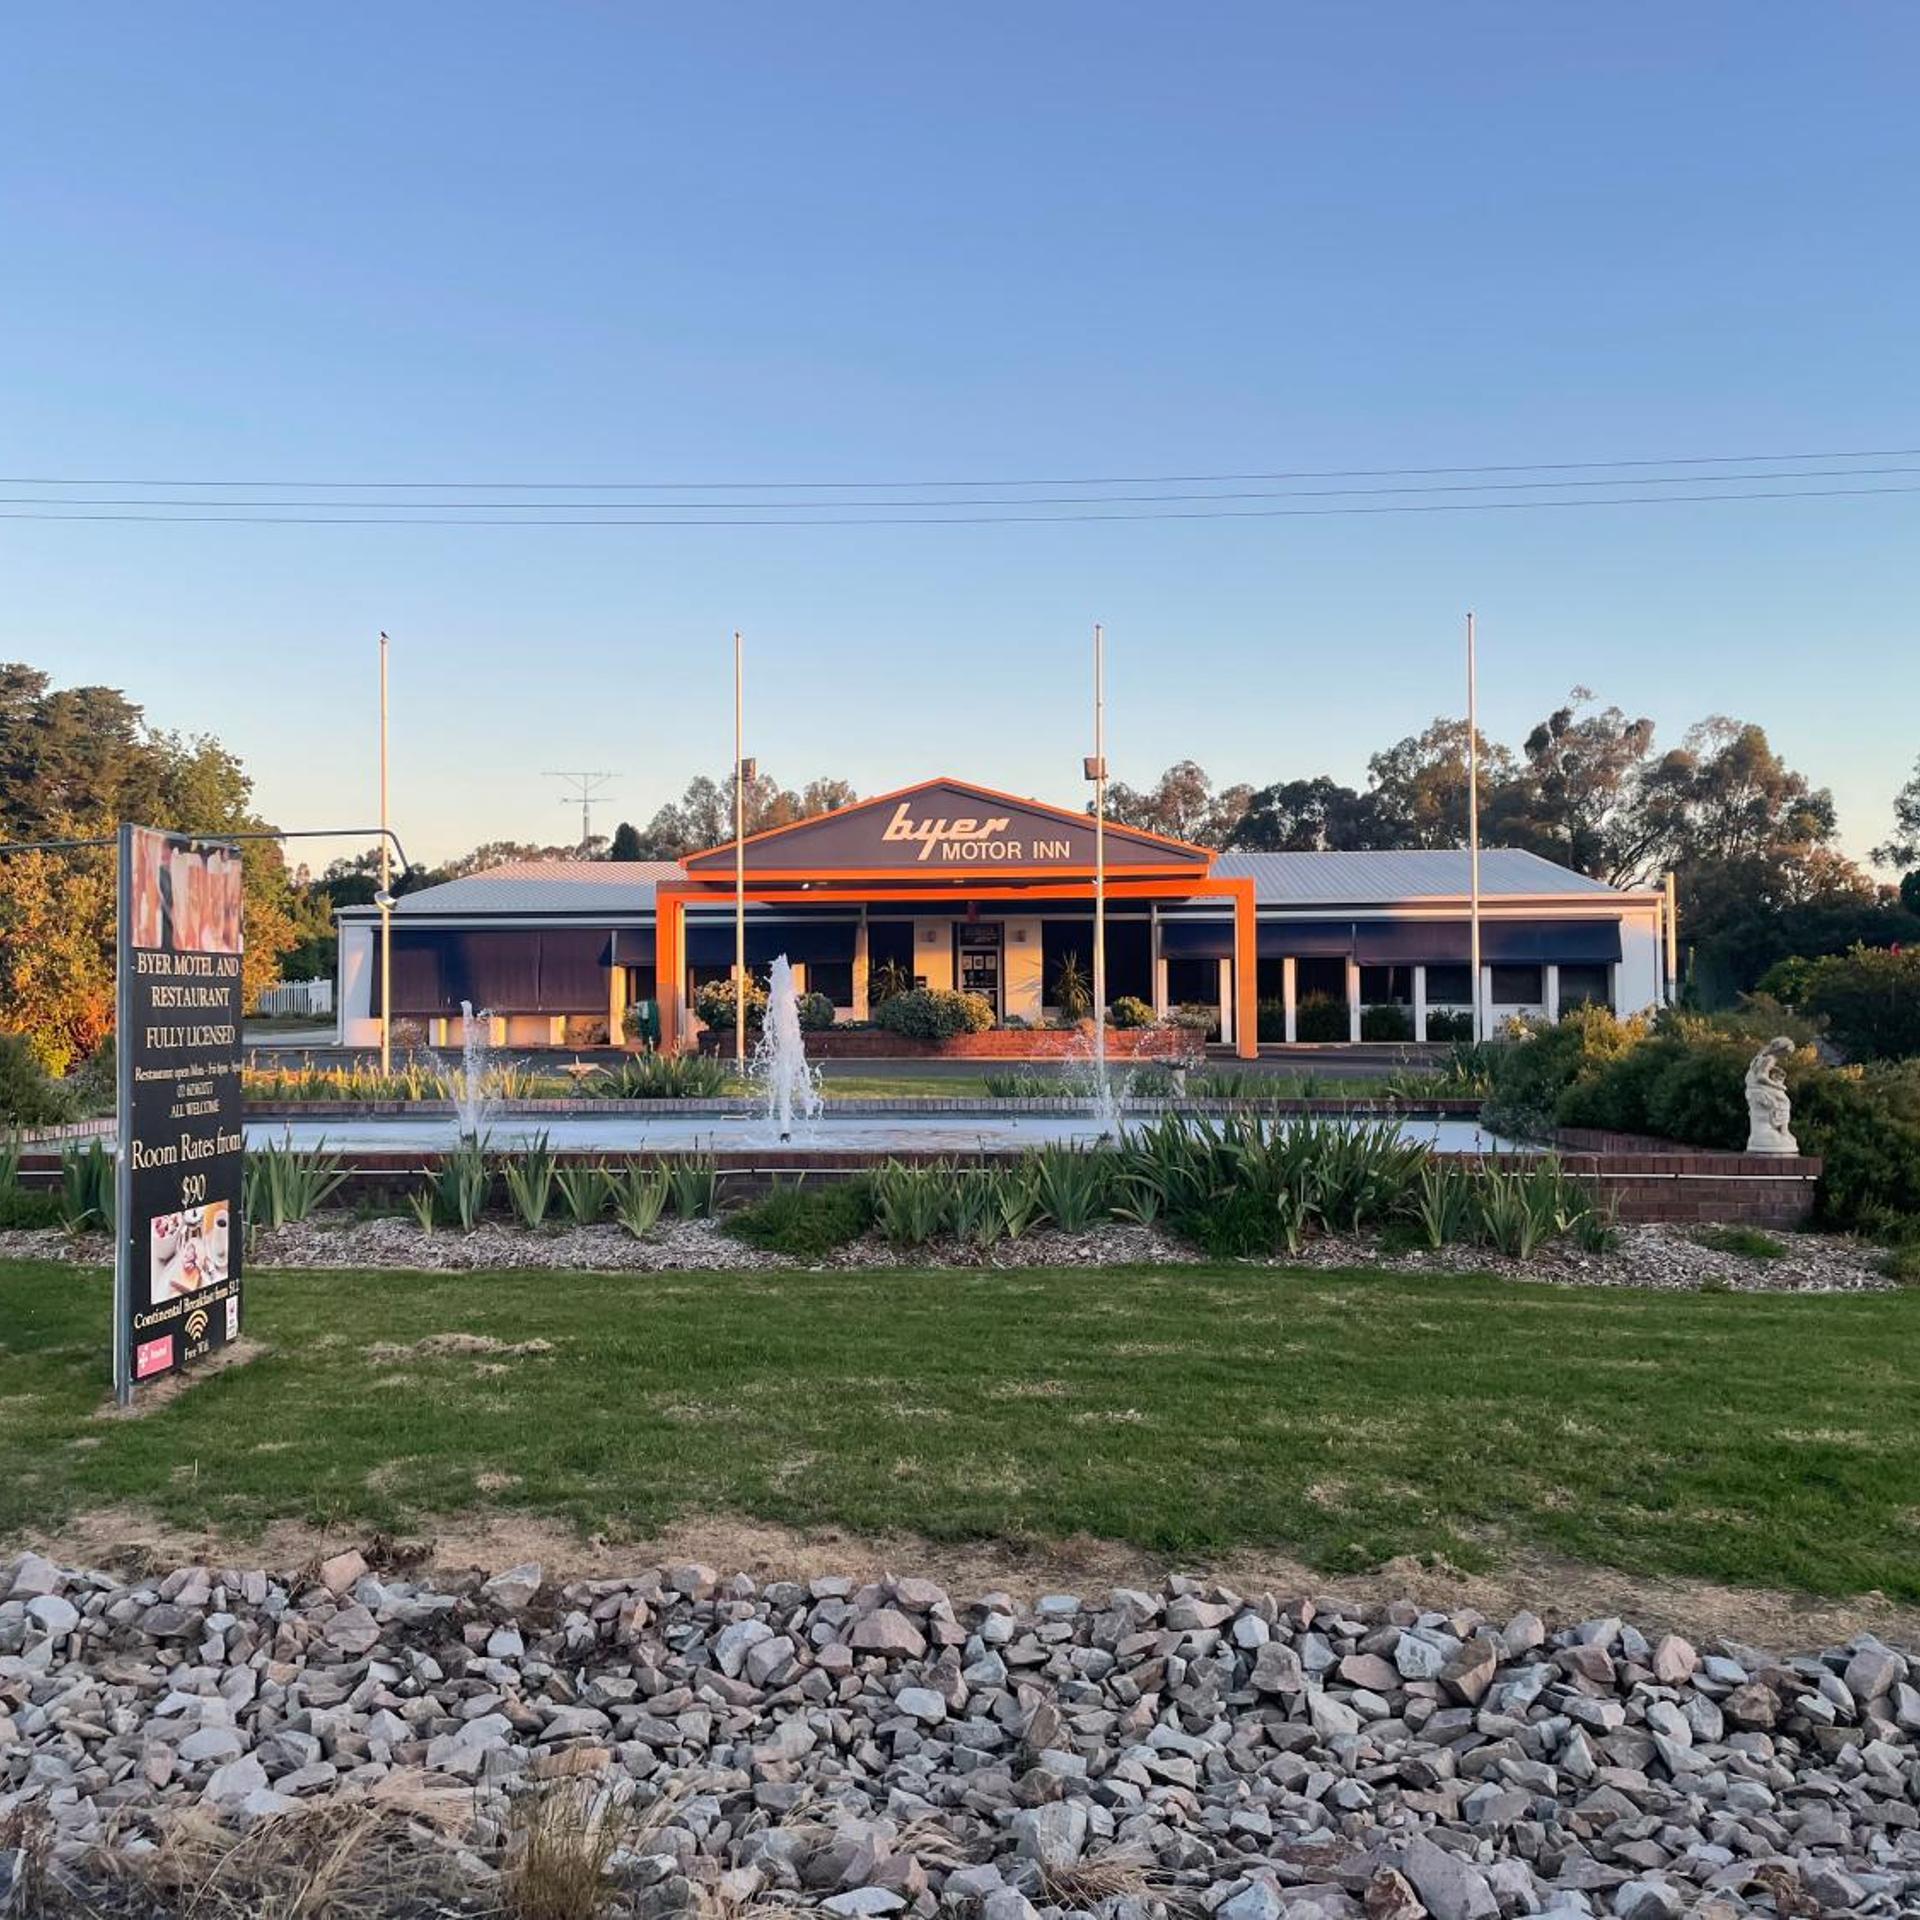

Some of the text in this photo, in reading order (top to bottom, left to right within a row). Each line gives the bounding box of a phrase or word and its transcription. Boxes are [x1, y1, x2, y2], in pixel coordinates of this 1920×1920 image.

[882, 803, 1010, 860] byer
[942, 840, 1070, 860] MOTOR INN
[137, 952, 239, 977] BYER MOTEL AND
[151, 985, 230, 1008] RESTAURANT
[146, 1025, 236, 1049] FULLY LICENSED
[169, 1103, 186, 1118] ALL
[131, 1126, 241, 1170] Room Rates from
[182, 1173, 207, 1208] $90
[134, 1298, 182, 1329] Continental
